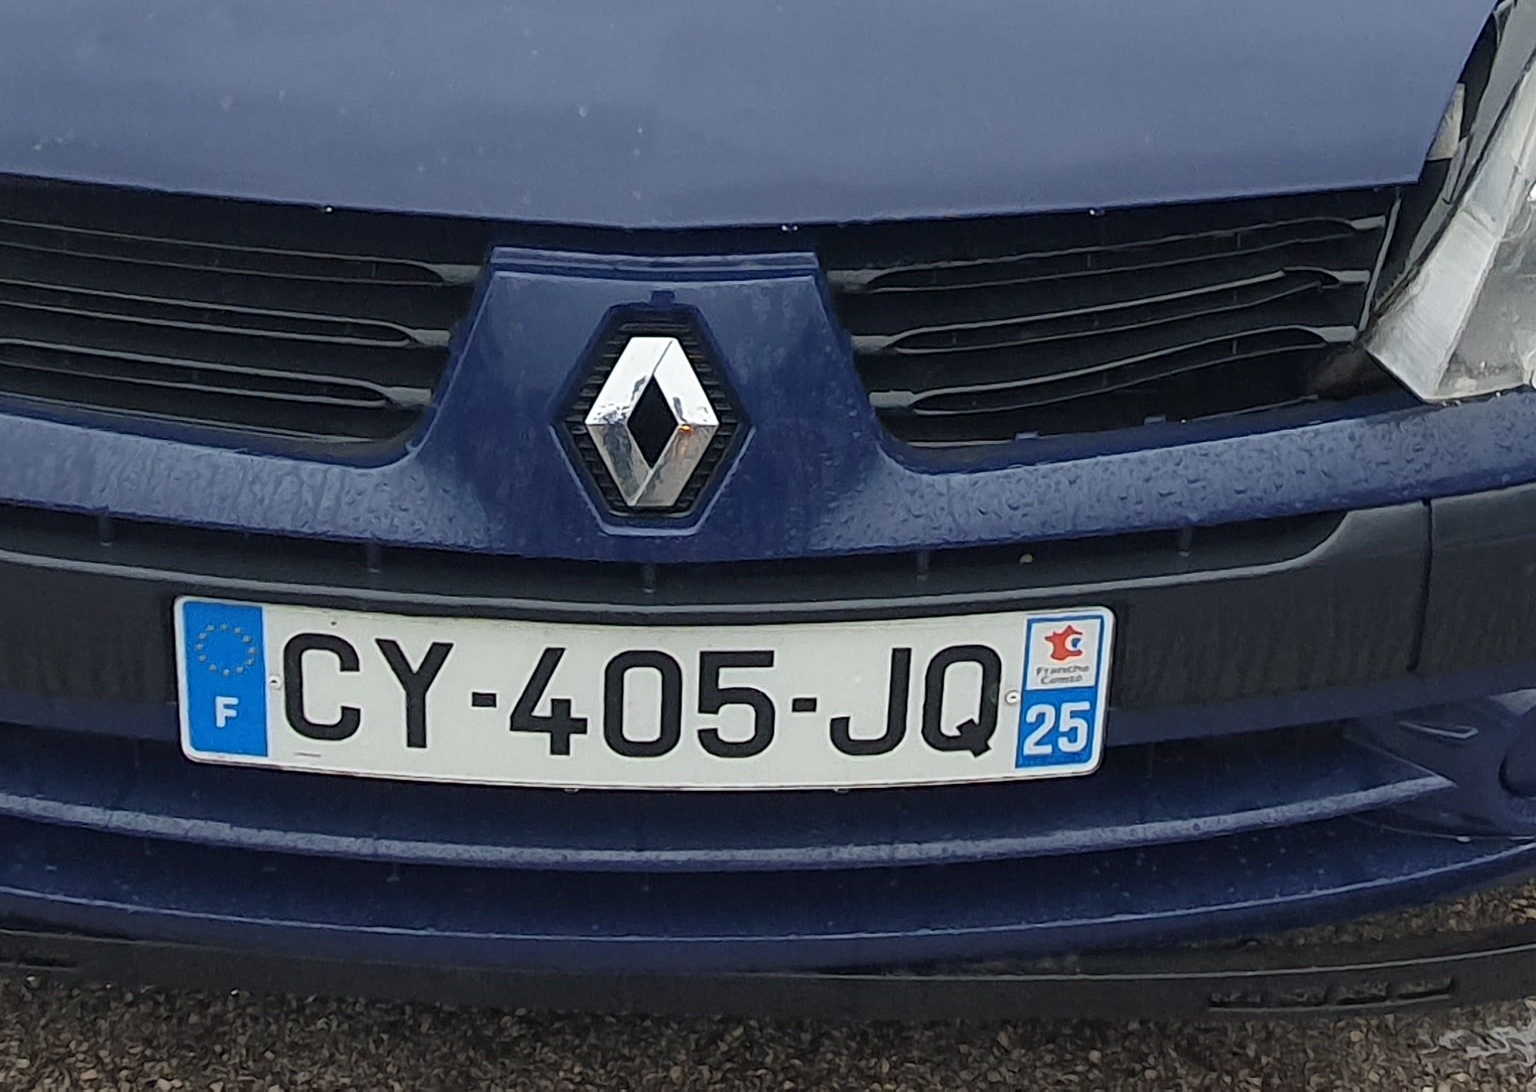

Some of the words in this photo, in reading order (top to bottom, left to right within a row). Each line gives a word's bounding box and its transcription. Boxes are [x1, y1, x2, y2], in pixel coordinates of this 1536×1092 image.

[215, 696, 240, 728] F
[283, 632, 1002, 758] CY-405-JQ
[1022, 700, 1092, 756] 25
